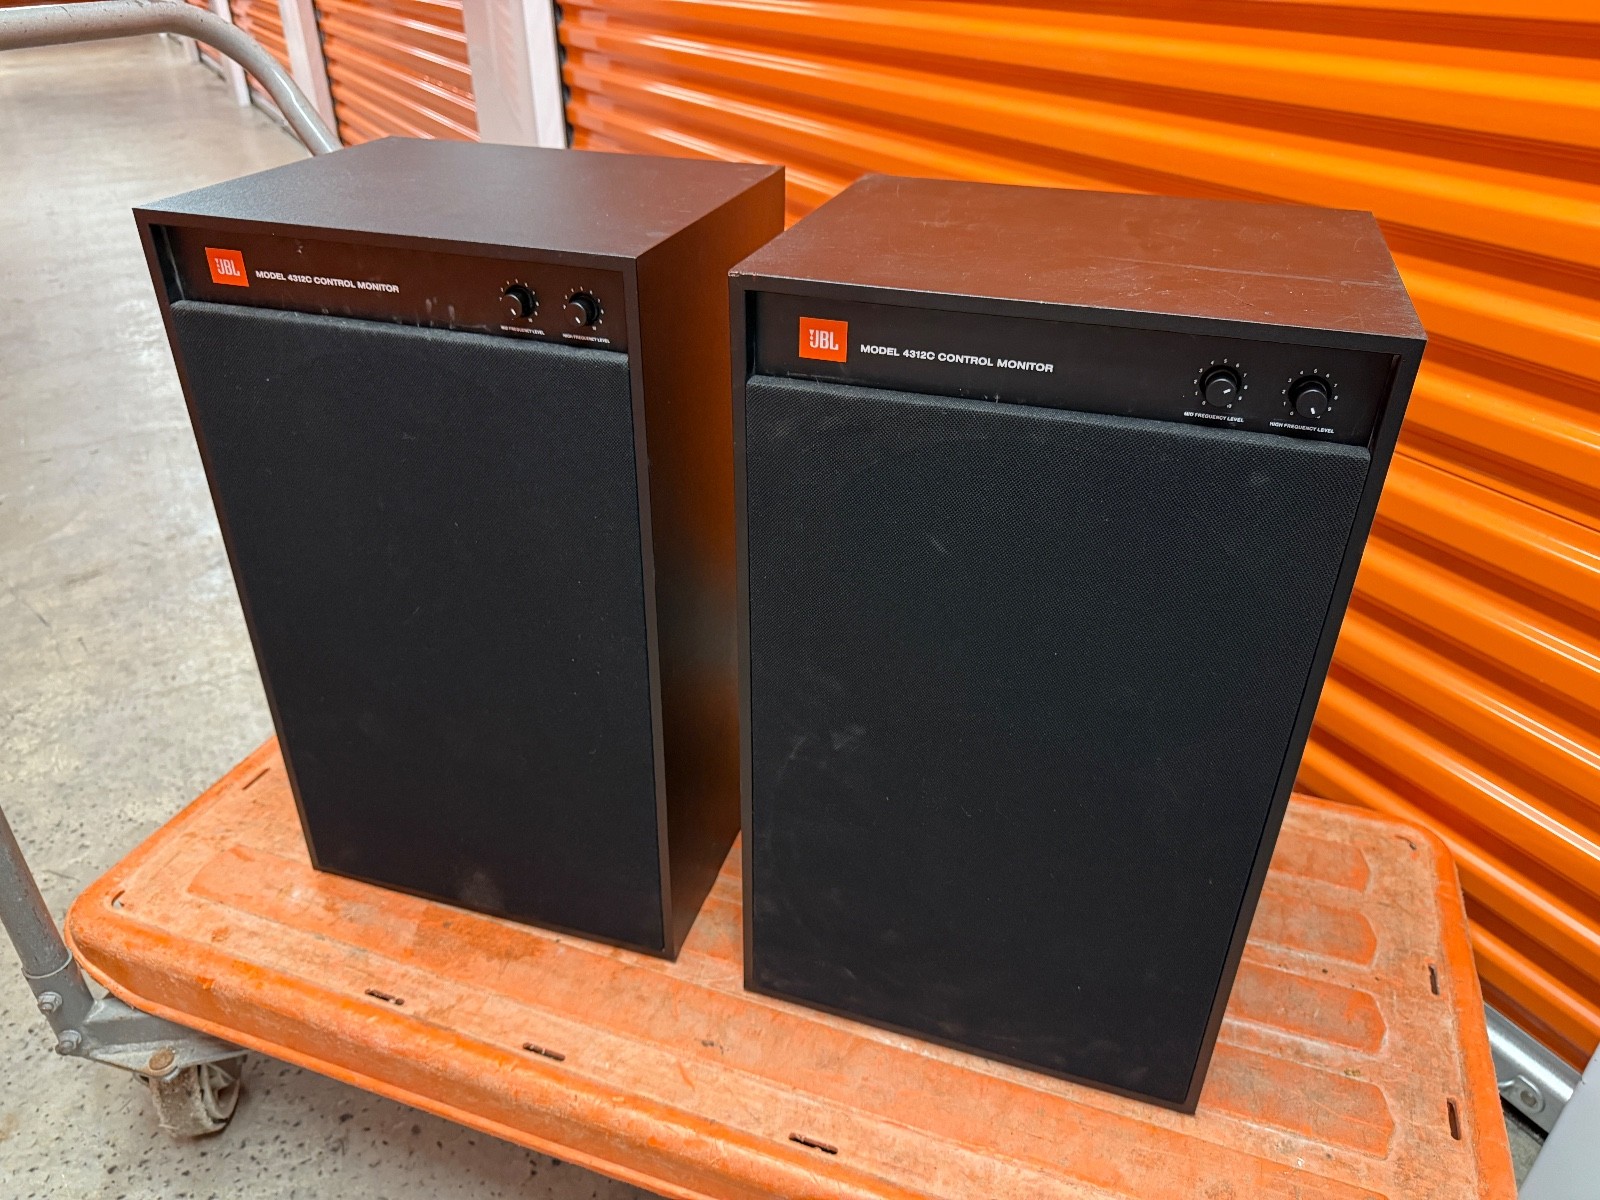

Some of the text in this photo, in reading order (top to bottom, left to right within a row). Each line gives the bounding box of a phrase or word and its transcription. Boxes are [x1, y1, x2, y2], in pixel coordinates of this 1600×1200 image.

[215, 257, 241, 277] JBL
[255, 270, 400, 293] MODEL 4312C CONTROL MONITOR
[809, 329, 839, 350] JBL
[860, 344, 1054, 373] MODEL 4312C CONTROL MONITOR
[1194, 412, 1227, 421] FREQUENCY
[1283, 423, 1317, 432] FREQUENCY
